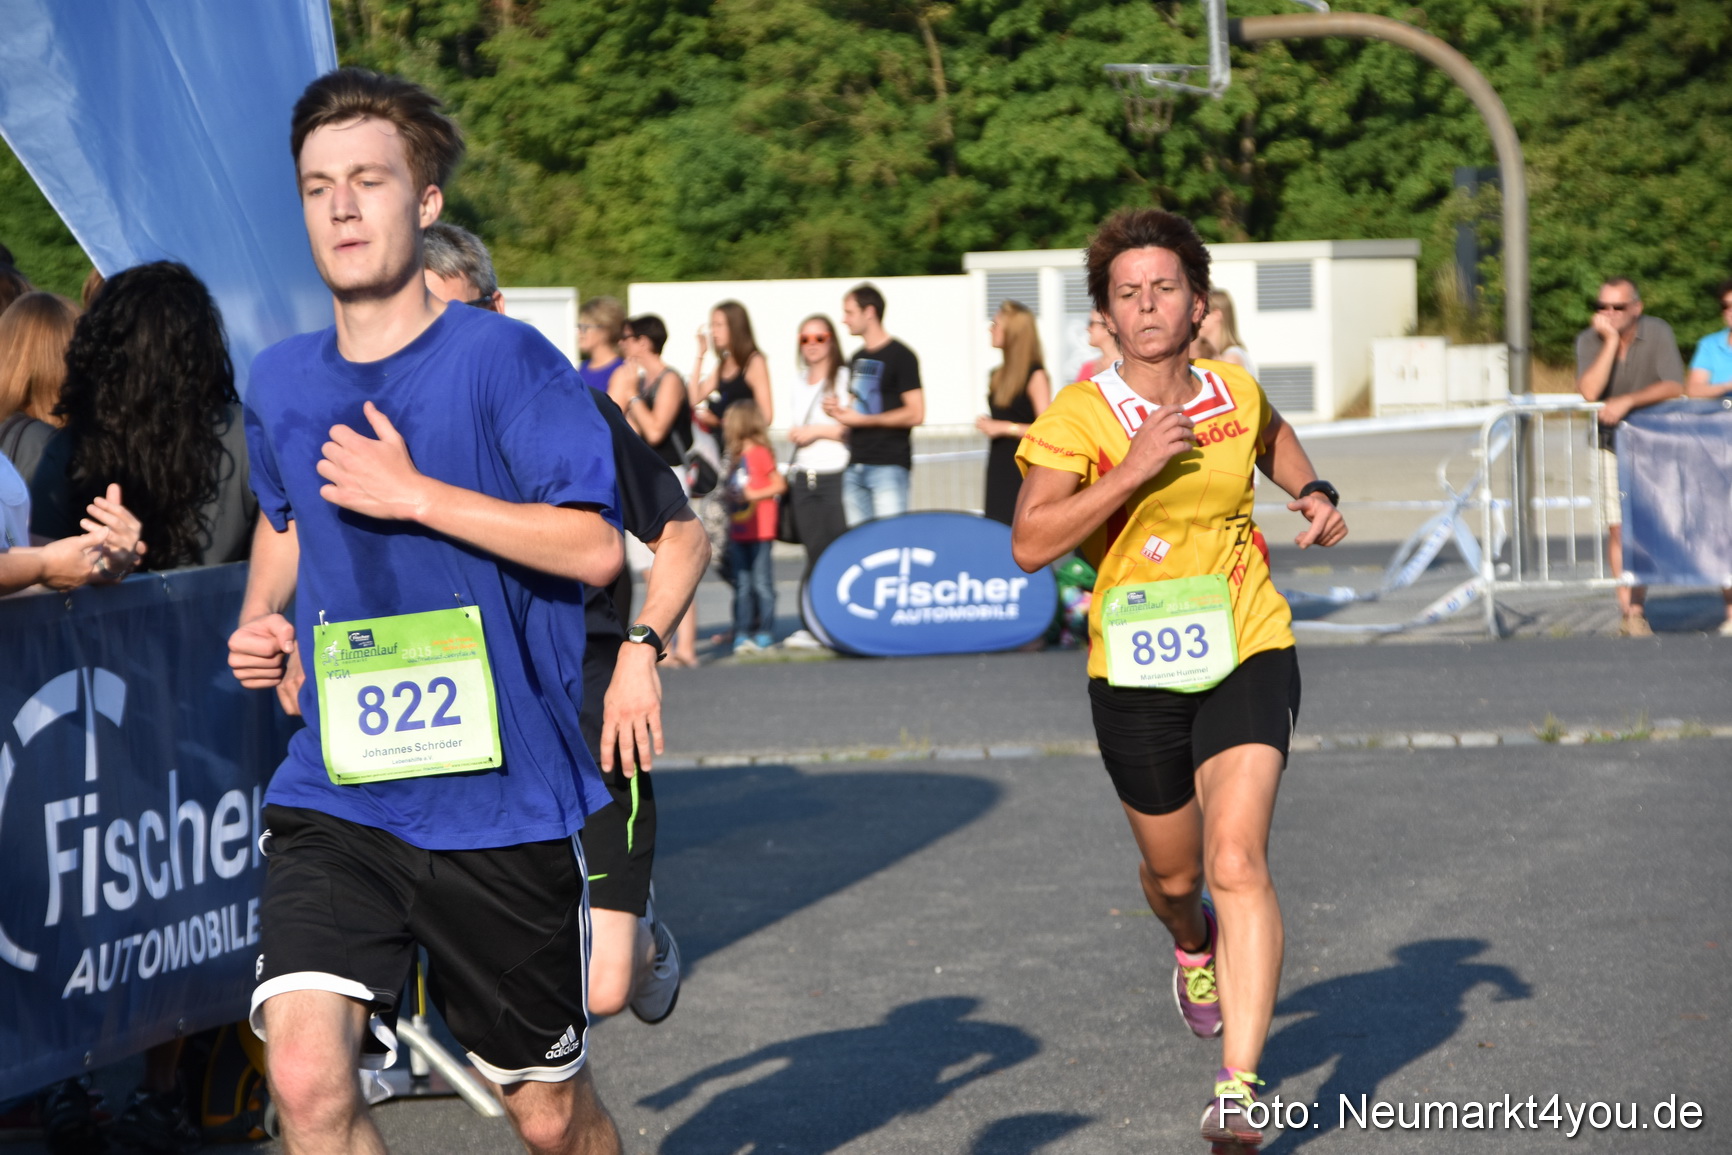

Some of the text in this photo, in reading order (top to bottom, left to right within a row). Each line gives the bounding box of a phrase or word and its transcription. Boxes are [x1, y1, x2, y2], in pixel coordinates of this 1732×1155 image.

[1196, 420, 1249, 447] BÖGL
[874, 571, 1028, 610] Fischer
[891, 603, 1019, 626] AUTOMOBILE
[1120, 600, 1164, 613] firmenlauf
[341, 642, 397, 660] firmenlauf
[1132, 623, 1209, 666] 893
[1140, 671, 1175, 681] Marianne
[1176, 666, 1208, 677] Hummel
[357, 676, 461, 736] 822
[362, 739, 463, 759] Johannes Schröder
[61, 897, 261, 999] AUTOMOBILE
[545, 1039, 580, 1060] adidas
